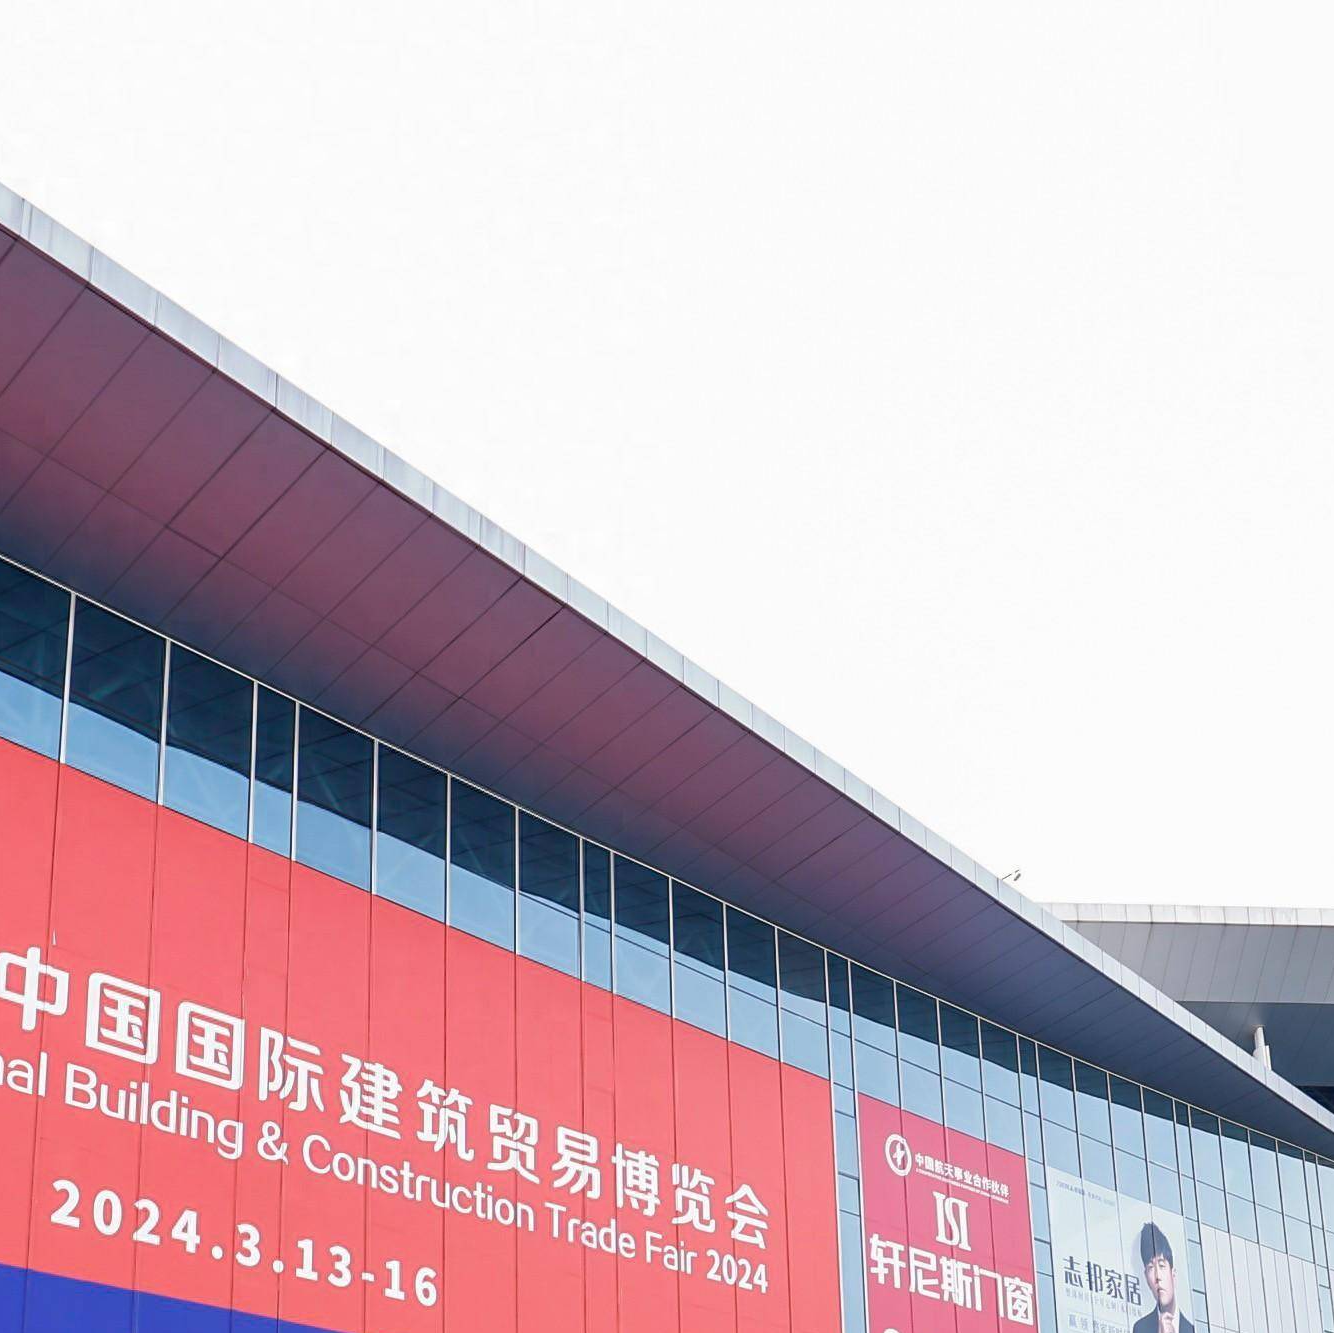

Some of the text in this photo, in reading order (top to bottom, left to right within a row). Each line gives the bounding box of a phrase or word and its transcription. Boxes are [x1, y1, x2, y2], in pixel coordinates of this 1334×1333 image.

[65, 1061, 244, 1161] Building
[257, 1119, 289, 1166] &
[302, 1135, 535, 1233] Construction
[544, 1202, 637, 1259] Trade
[644, 1232, 695, 1276] Fair
[705, 1249, 769, 1294] 2024
[50, 1179, 438, 1308] 2024.3.13-16
[869, 1233, 1034, 1326] 轩尼斯门窗
[1063, 1255, 1141, 1306] 志邦家居
